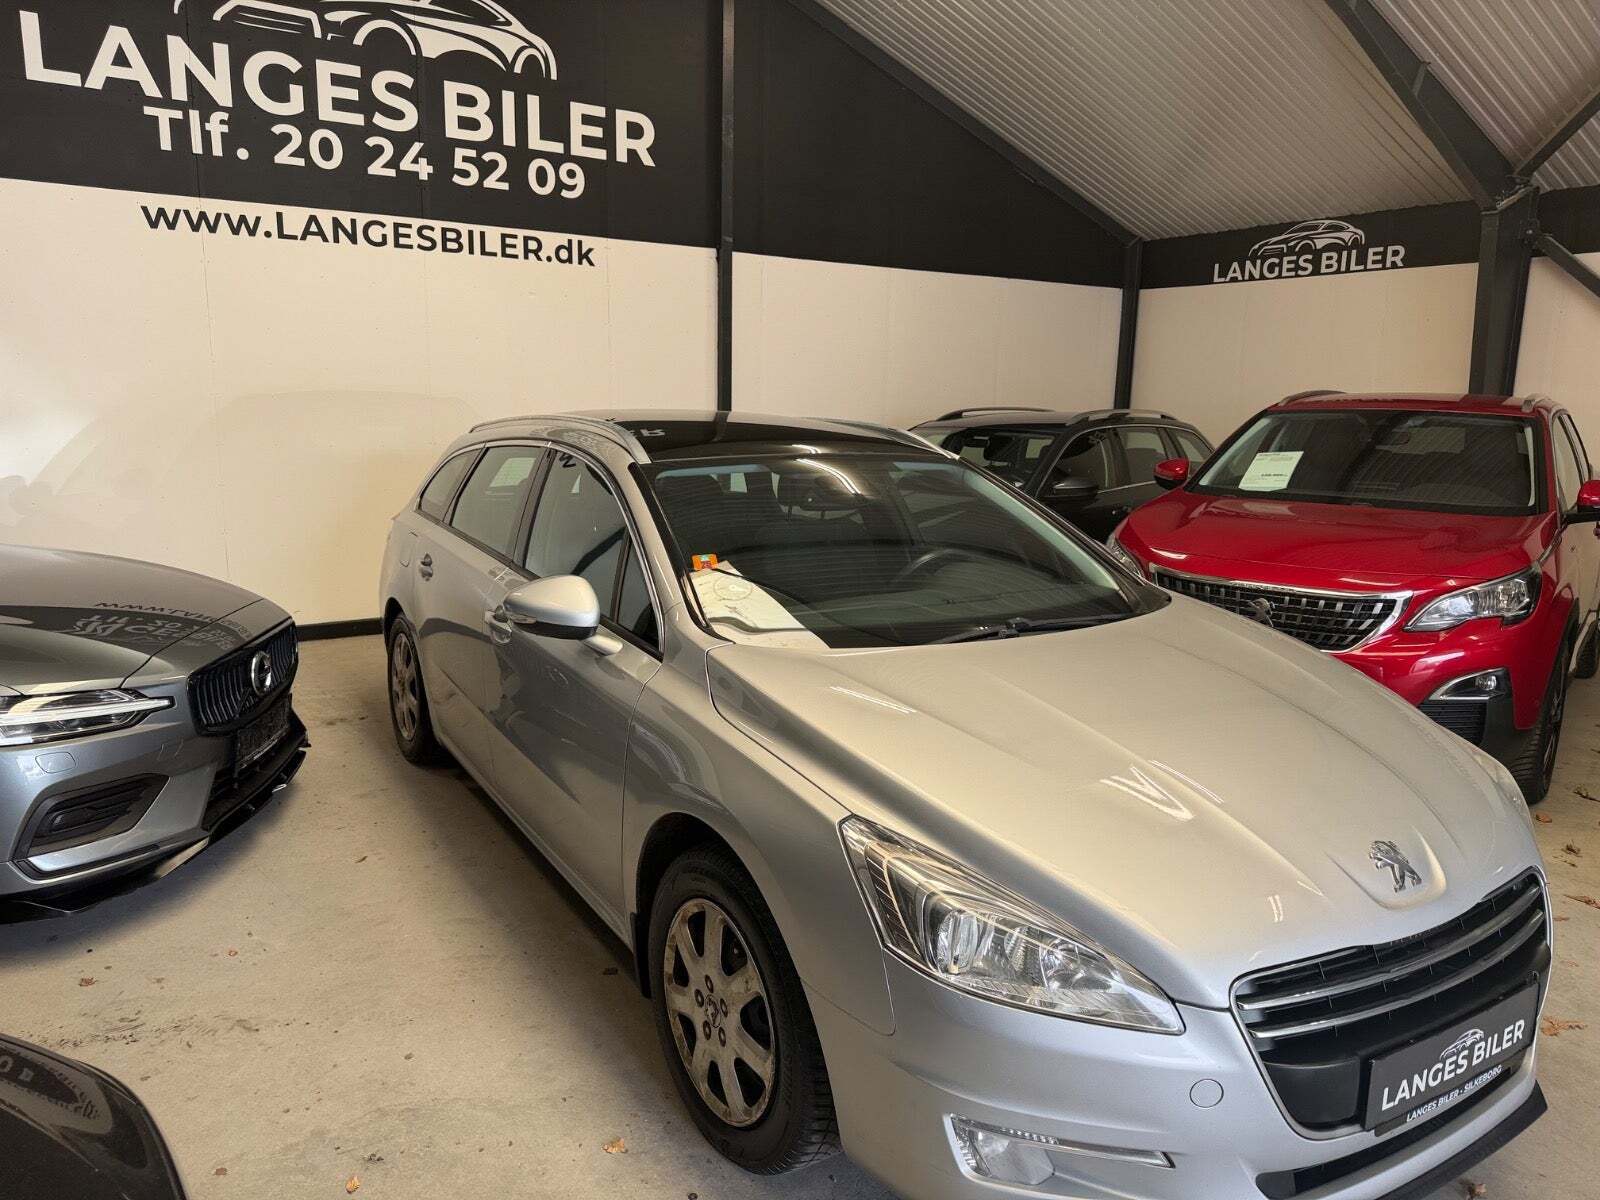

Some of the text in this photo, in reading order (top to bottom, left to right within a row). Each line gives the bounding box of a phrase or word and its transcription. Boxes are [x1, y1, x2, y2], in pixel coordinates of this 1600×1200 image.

[18, 9, 656, 167] LANGES BILER
[143, 105, 586, 199] Tlf. 20 24 52 09
[140, 205, 595, 267] www.LANGESBILER.dk
[1212, 245, 1406, 283] LANGES BILER
[1381, 1020, 1524, 1111] LANGES BILER
[1406, 1101, 1437, 1121] LANGES
[1438, 1089, 1460, 1108] BILER
[1464, 1065, 1502, 1091] SILKEBORG
